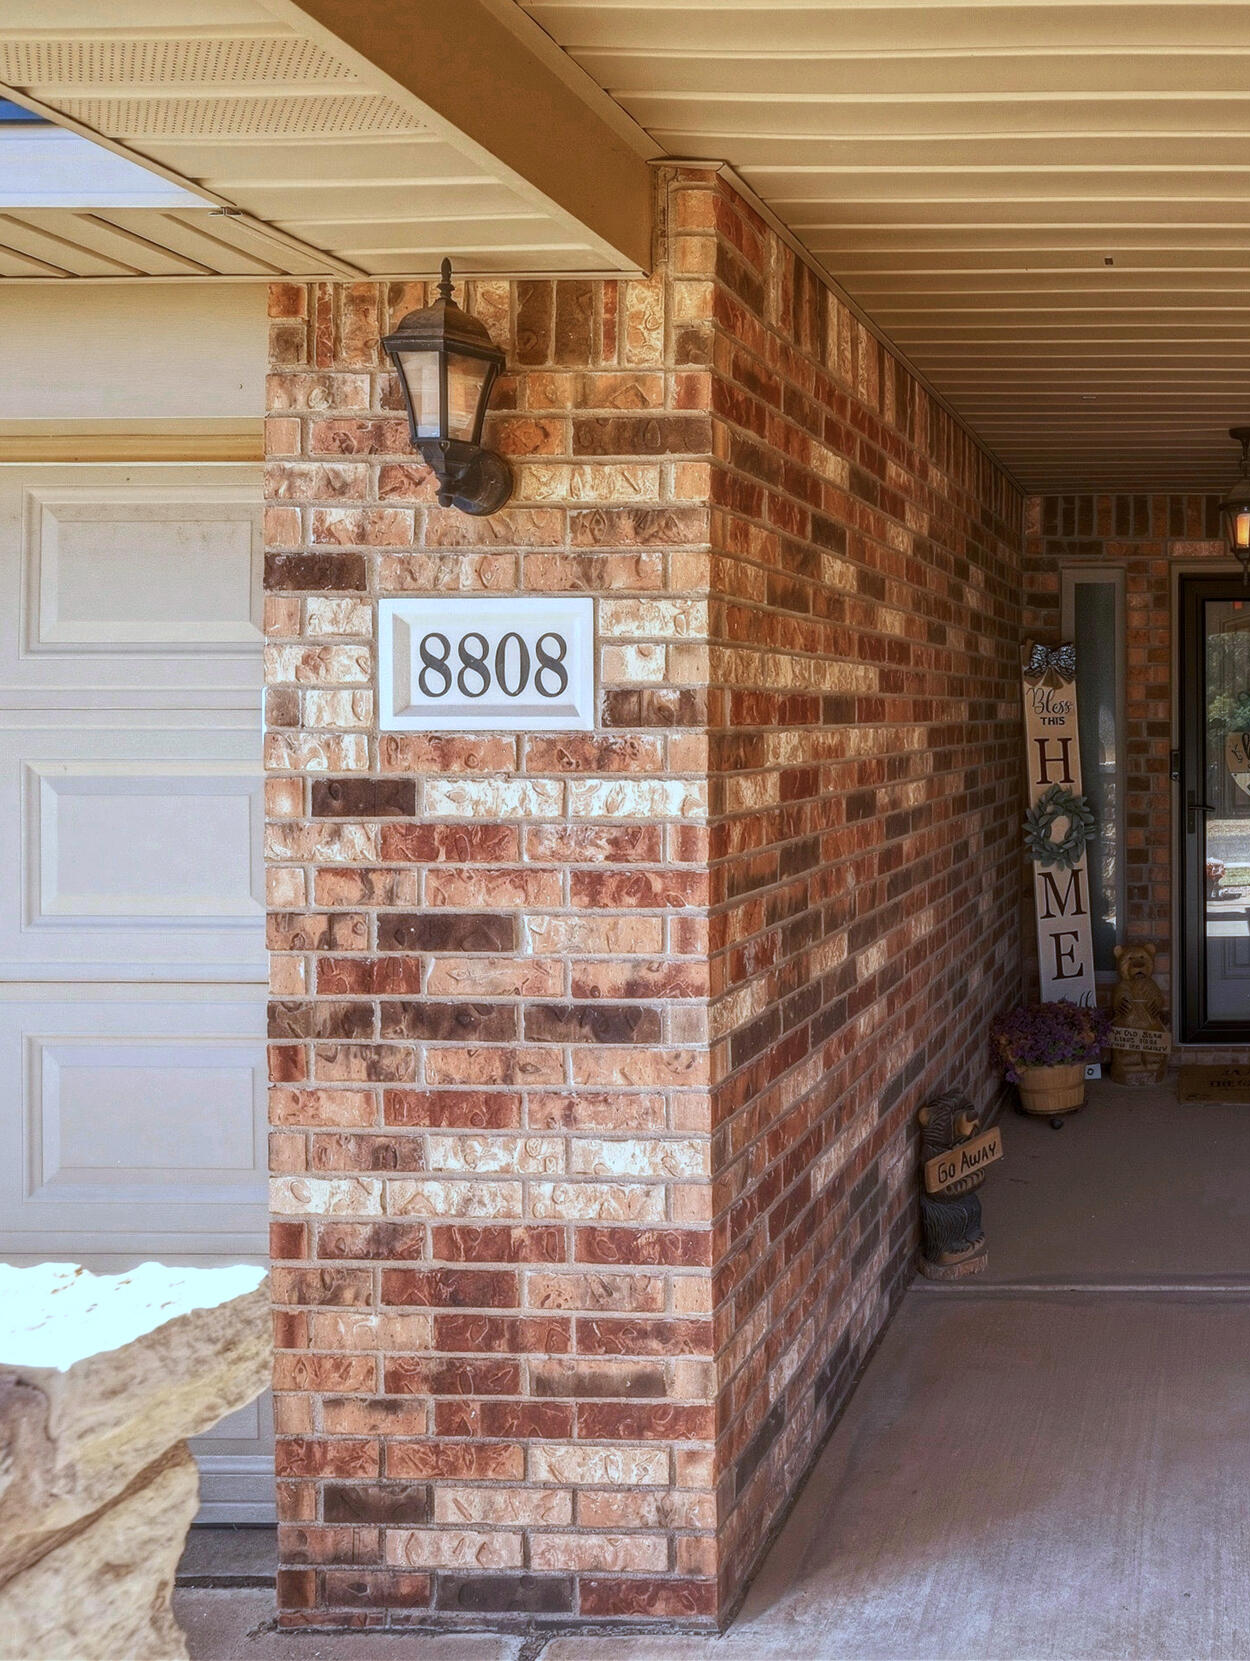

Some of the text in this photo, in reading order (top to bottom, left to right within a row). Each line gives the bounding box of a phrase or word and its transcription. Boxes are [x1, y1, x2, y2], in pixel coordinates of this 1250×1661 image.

[418, 631, 568, 698] 8808
[1025, 687, 1073, 715] Bless
[1040, 716, 1066, 726] THIS
